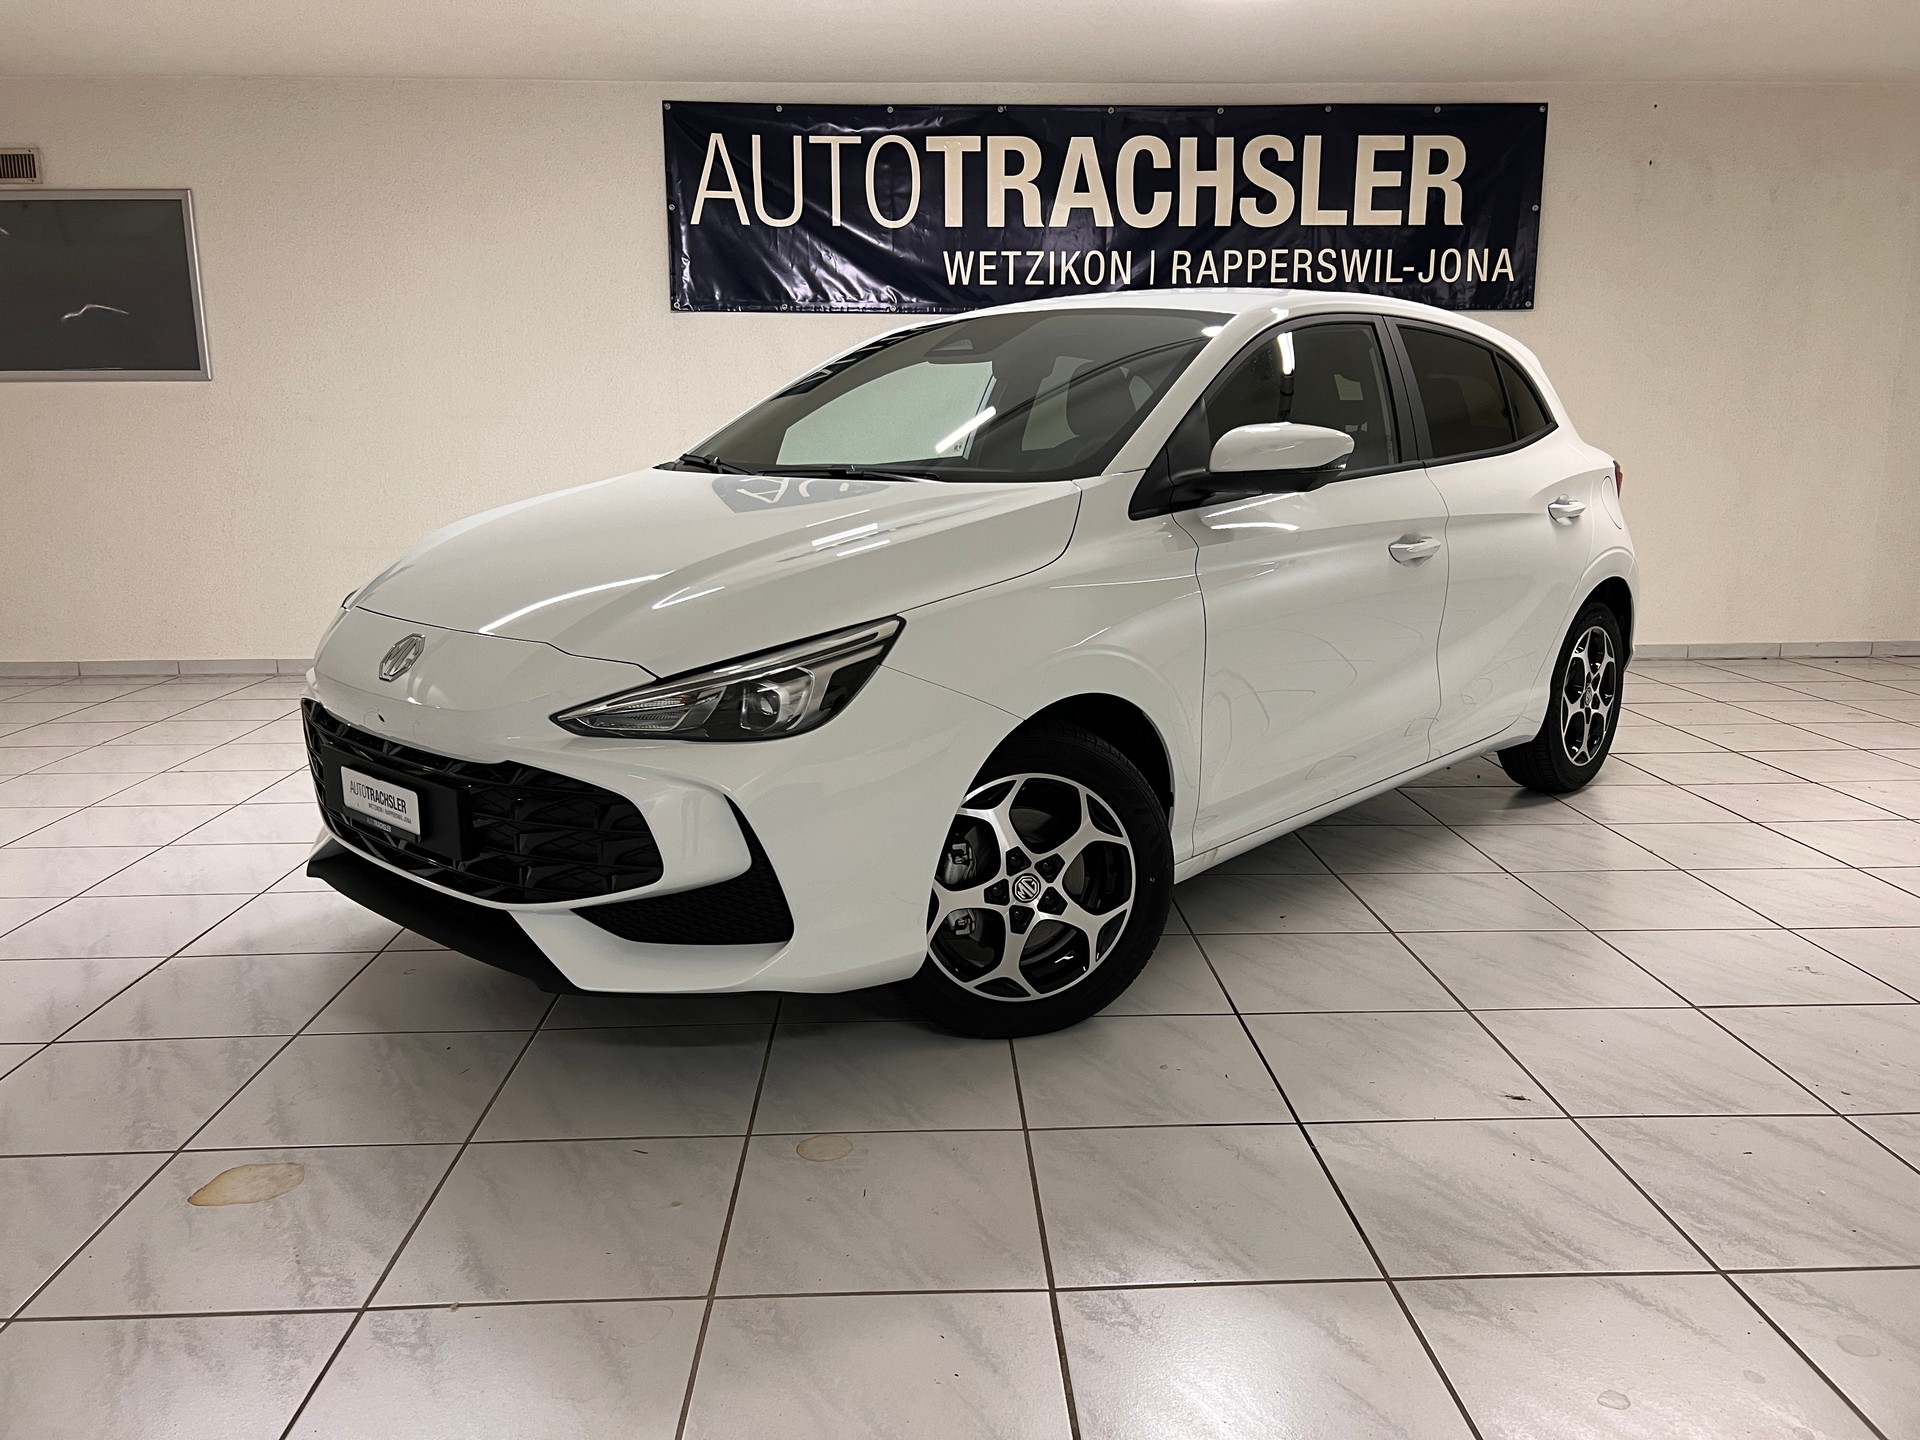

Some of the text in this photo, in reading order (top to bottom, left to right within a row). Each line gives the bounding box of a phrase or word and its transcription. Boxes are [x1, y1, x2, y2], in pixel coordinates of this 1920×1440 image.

[690, 133, 1467, 229] AUTOTRACHSLER
[943, 250, 1132, 286] WETZIKON
[1171, 248, 1515, 285] RAPPERSWIL-JONA
[349, 780, 408, 814] AUTOTRACHSLER
[1015, 876, 1040, 901] MG
